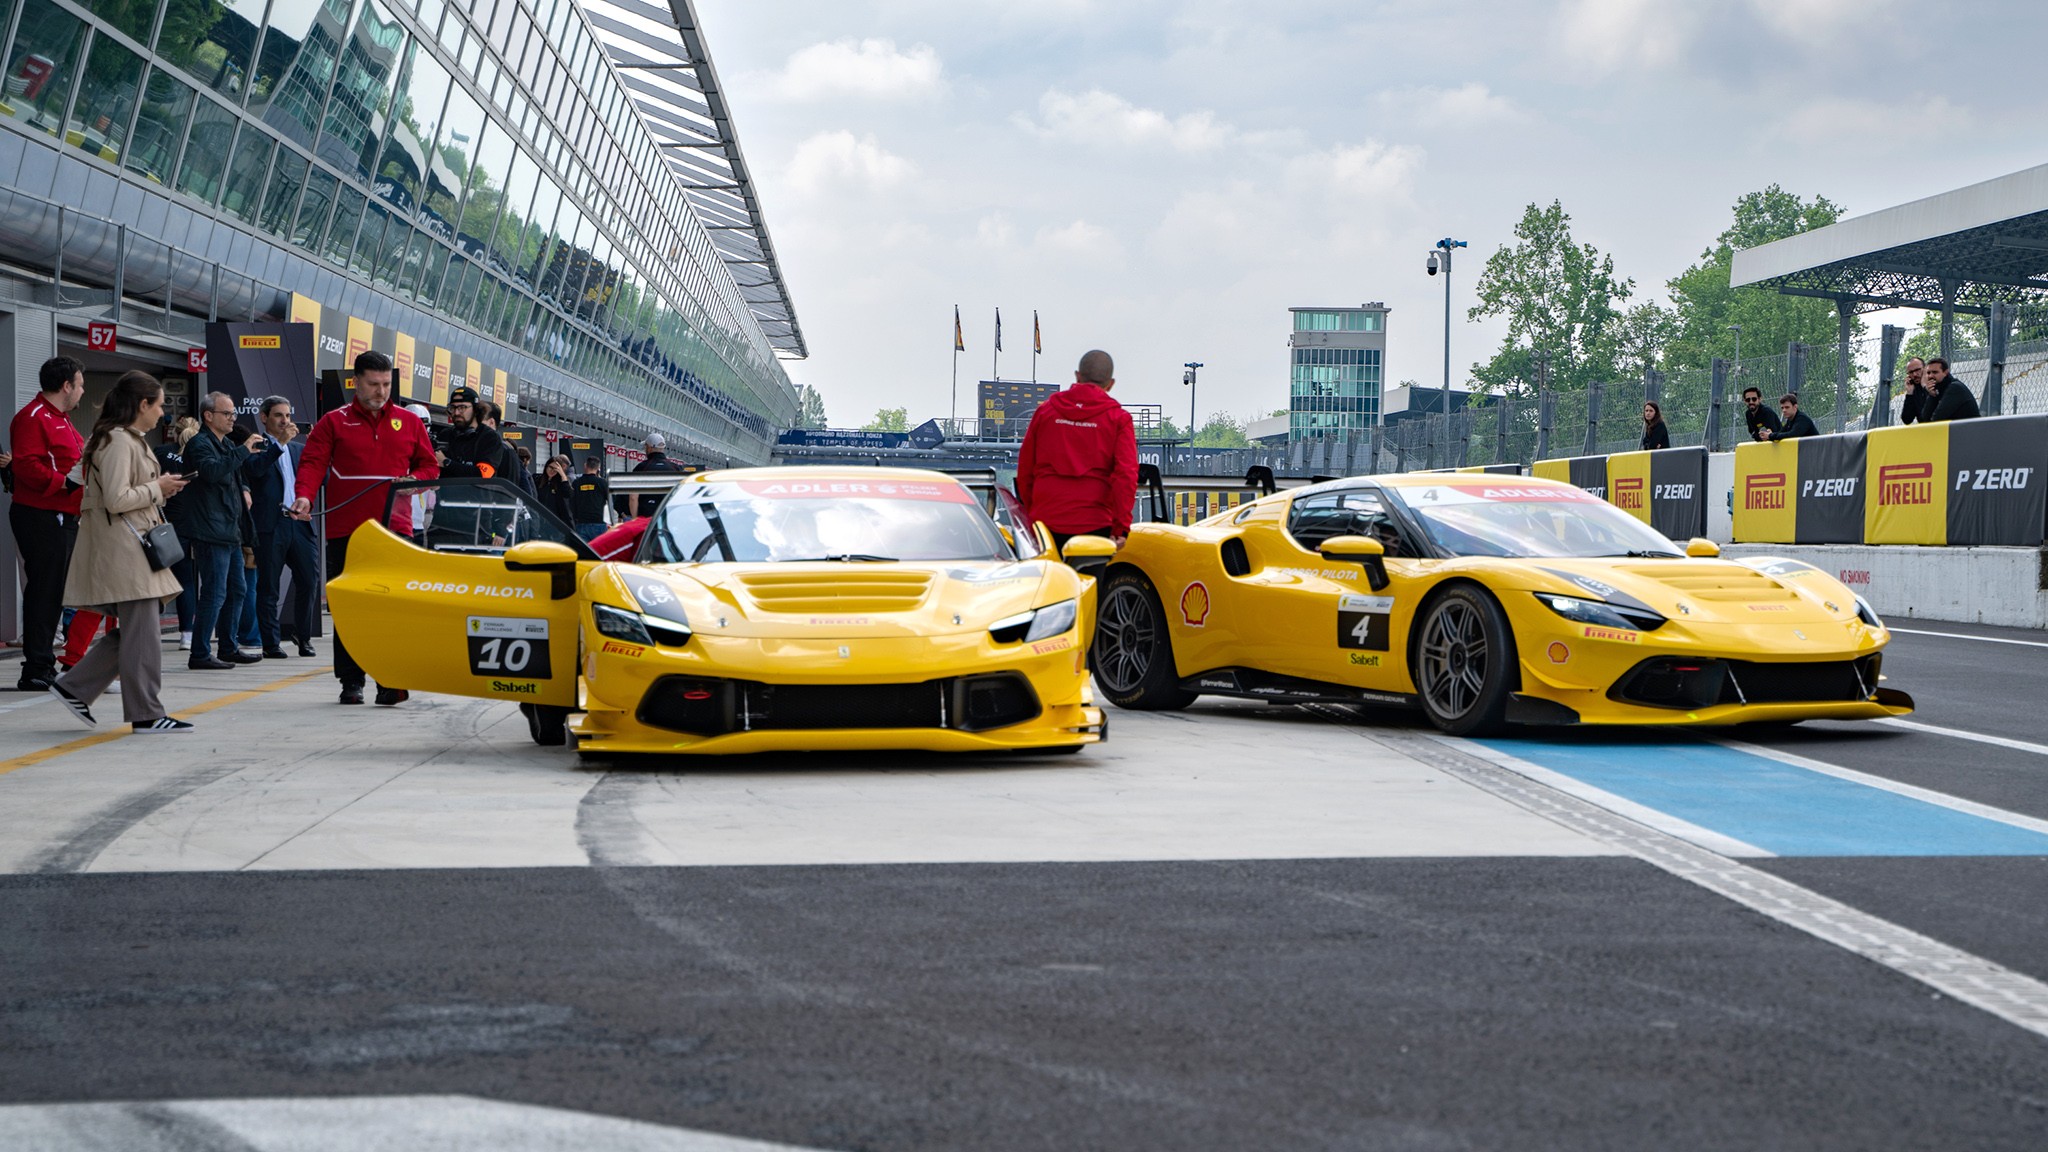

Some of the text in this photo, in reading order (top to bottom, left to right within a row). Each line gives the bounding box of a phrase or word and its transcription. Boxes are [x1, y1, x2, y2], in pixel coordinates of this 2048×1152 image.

[91, 327, 114, 346] 57
[242, 337, 277, 347] PIRELLI
[320, 334, 326, 348] P
[325, 336, 345, 355] ZERO
[243, 396, 263, 406] PAG
[546, 432, 557, 440] 47
[759, 483, 871, 495] ADLER
[1745, 472, 1856, 510] PIRELLI P ZERO
[1879, 462, 2030, 506] PIRELLI P ZERO
[1422, 488, 1440, 501] 4
[1483, 487, 1555, 499] ADLER
[1615, 477, 1694, 509] PIRELLI P ZERO
[1321, 568, 1359, 580] PILOTA
[1848, 570, 1870, 584] SMOKING
[406, 580, 534, 599] CORSO PILOTA
[809, 618, 869, 626] PIRELLI
[1351, 614, 1371, 645] 4
[1584, 626, 1638, 643] PIRELLI
[602, 641, 646, 658] PIRELLI
[1031, 637, 1071, 654] PIRELLI
[477, 638, 532, 672] 10
[1350, 652, 1379, 667] Sabelt
[492, 680, 537, 694] Sabelt
